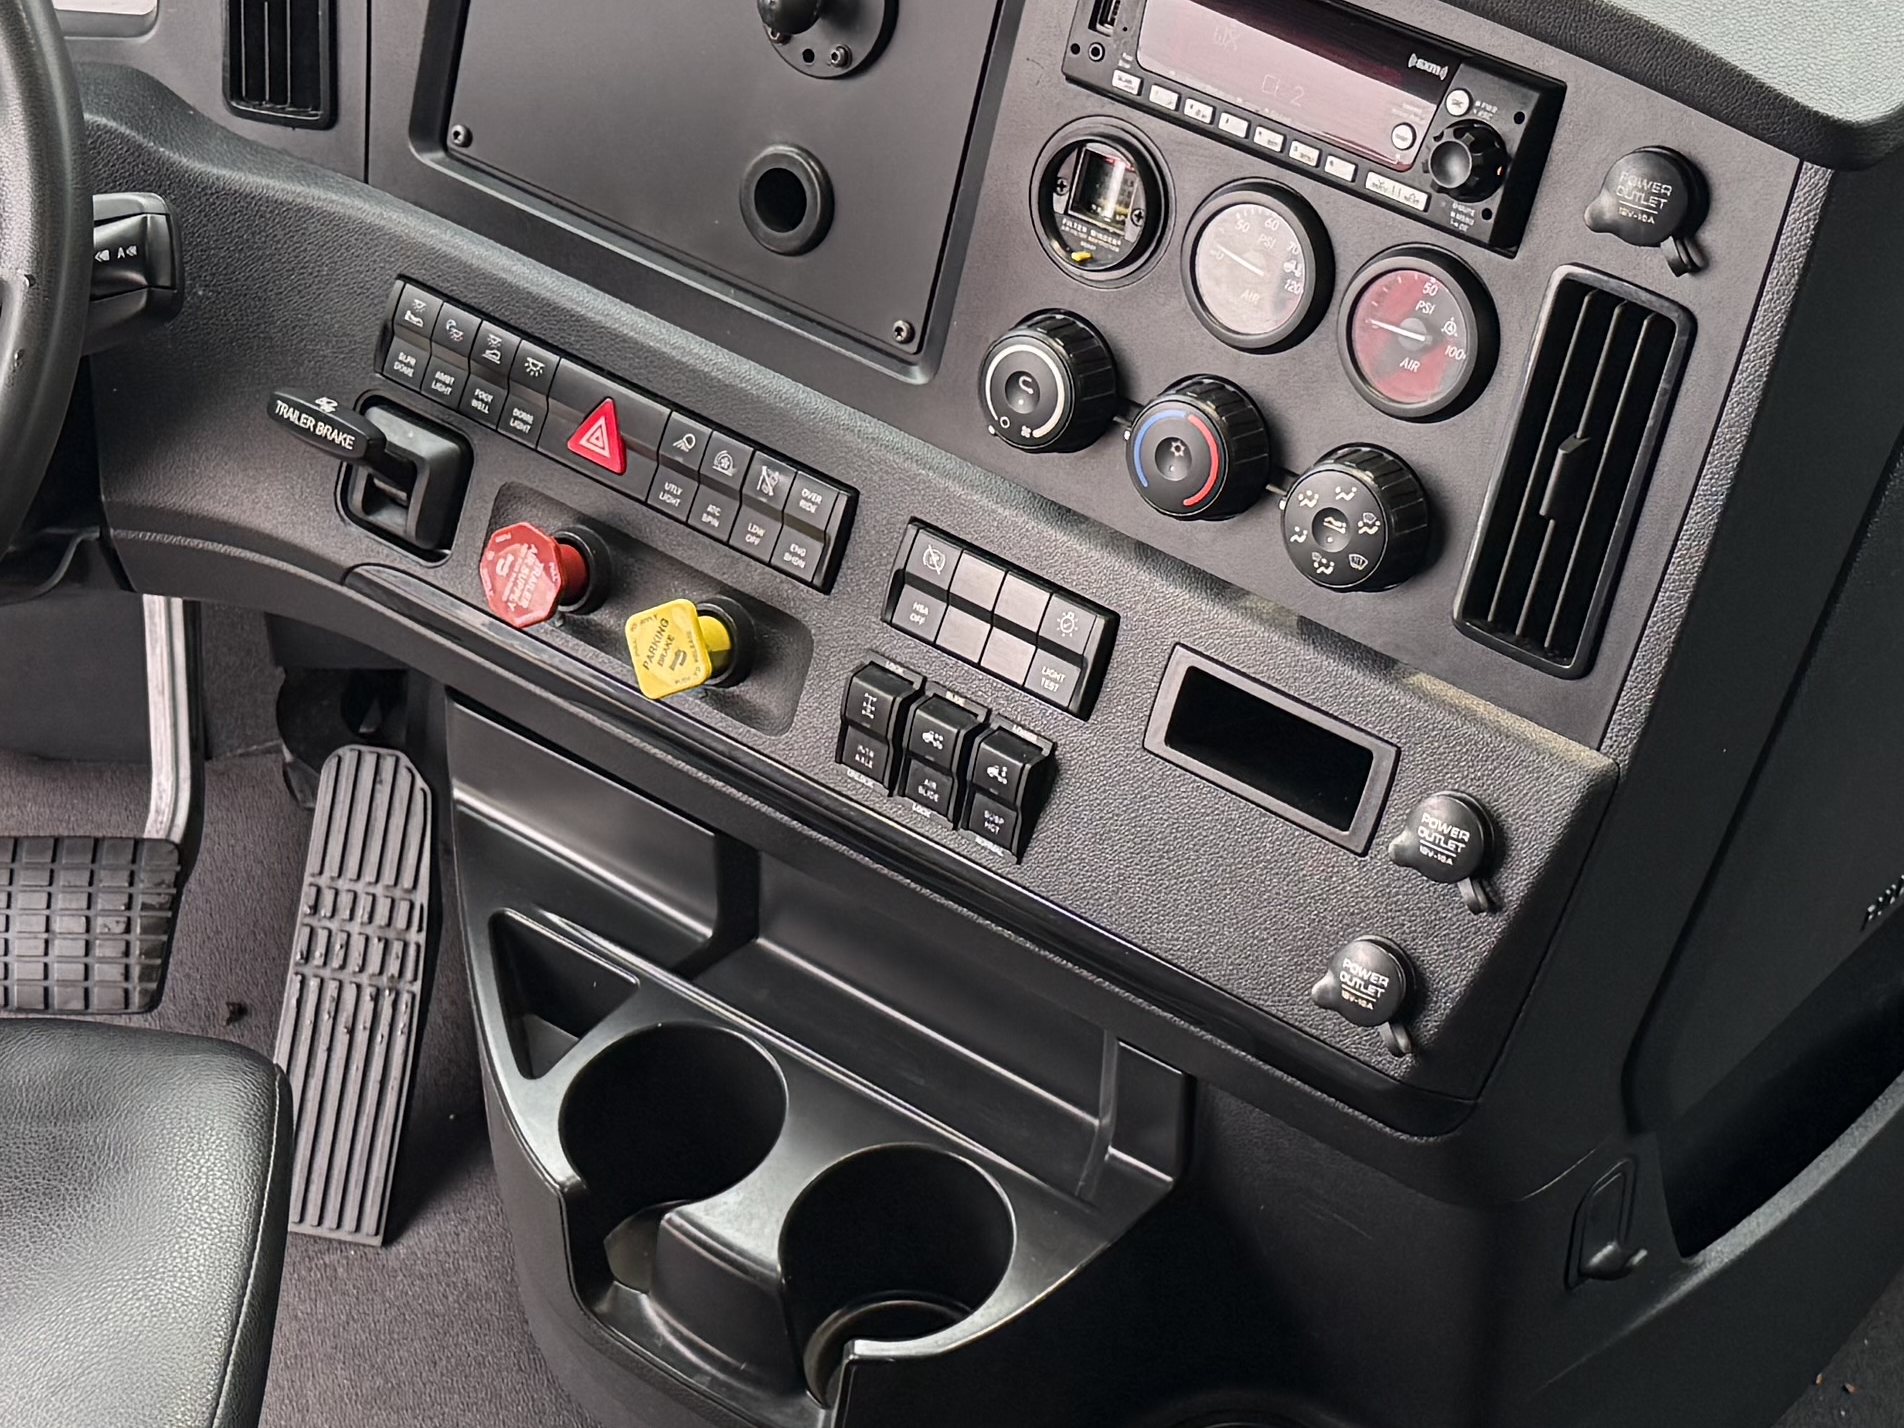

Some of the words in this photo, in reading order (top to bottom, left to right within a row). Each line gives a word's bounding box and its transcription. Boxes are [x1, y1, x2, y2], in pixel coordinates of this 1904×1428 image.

[1619, 171, 1673, 197] POWER
[1616, 185, 1669, 209] OUTLET
[1235, 219, 1250, 232] 50
[1264, 217, 1280, 231] 60
[1257, 233, 1276, 249] PSI
[1422, 282, 1439, 296] 50
[1415, 300, 1436, 314] PSI
[1444, 345, 1464, 360] 100
[1399, 357, 1421, 373] AIR
[431, 381, 453, 395] LIGHT
[471, 398, 490, 414] WELL
[275, 400, 315, 432] TRAILER
[315, 421, 356, 450] BRAKE
[658, 491, 682, 507] LIGHT
[801, 488, 823, 504] OVER
[745, 532, 761, 546] OFF
[909, 612, 926, 626] OFF
[642, 618, 670, 671] PARKING
[657, 634, 675, 667] BRAKE
[1041, 666, 1066, 682] LIGHT
[1040, 677, 1060, 693] TEST
[1421, 812, 1470, 842] POWER
[1417, 825, 1466, 853] OUTLET
[1342, 957, 1390, 987] POWER
[1339, 970, 1385, 998] OUTLET
